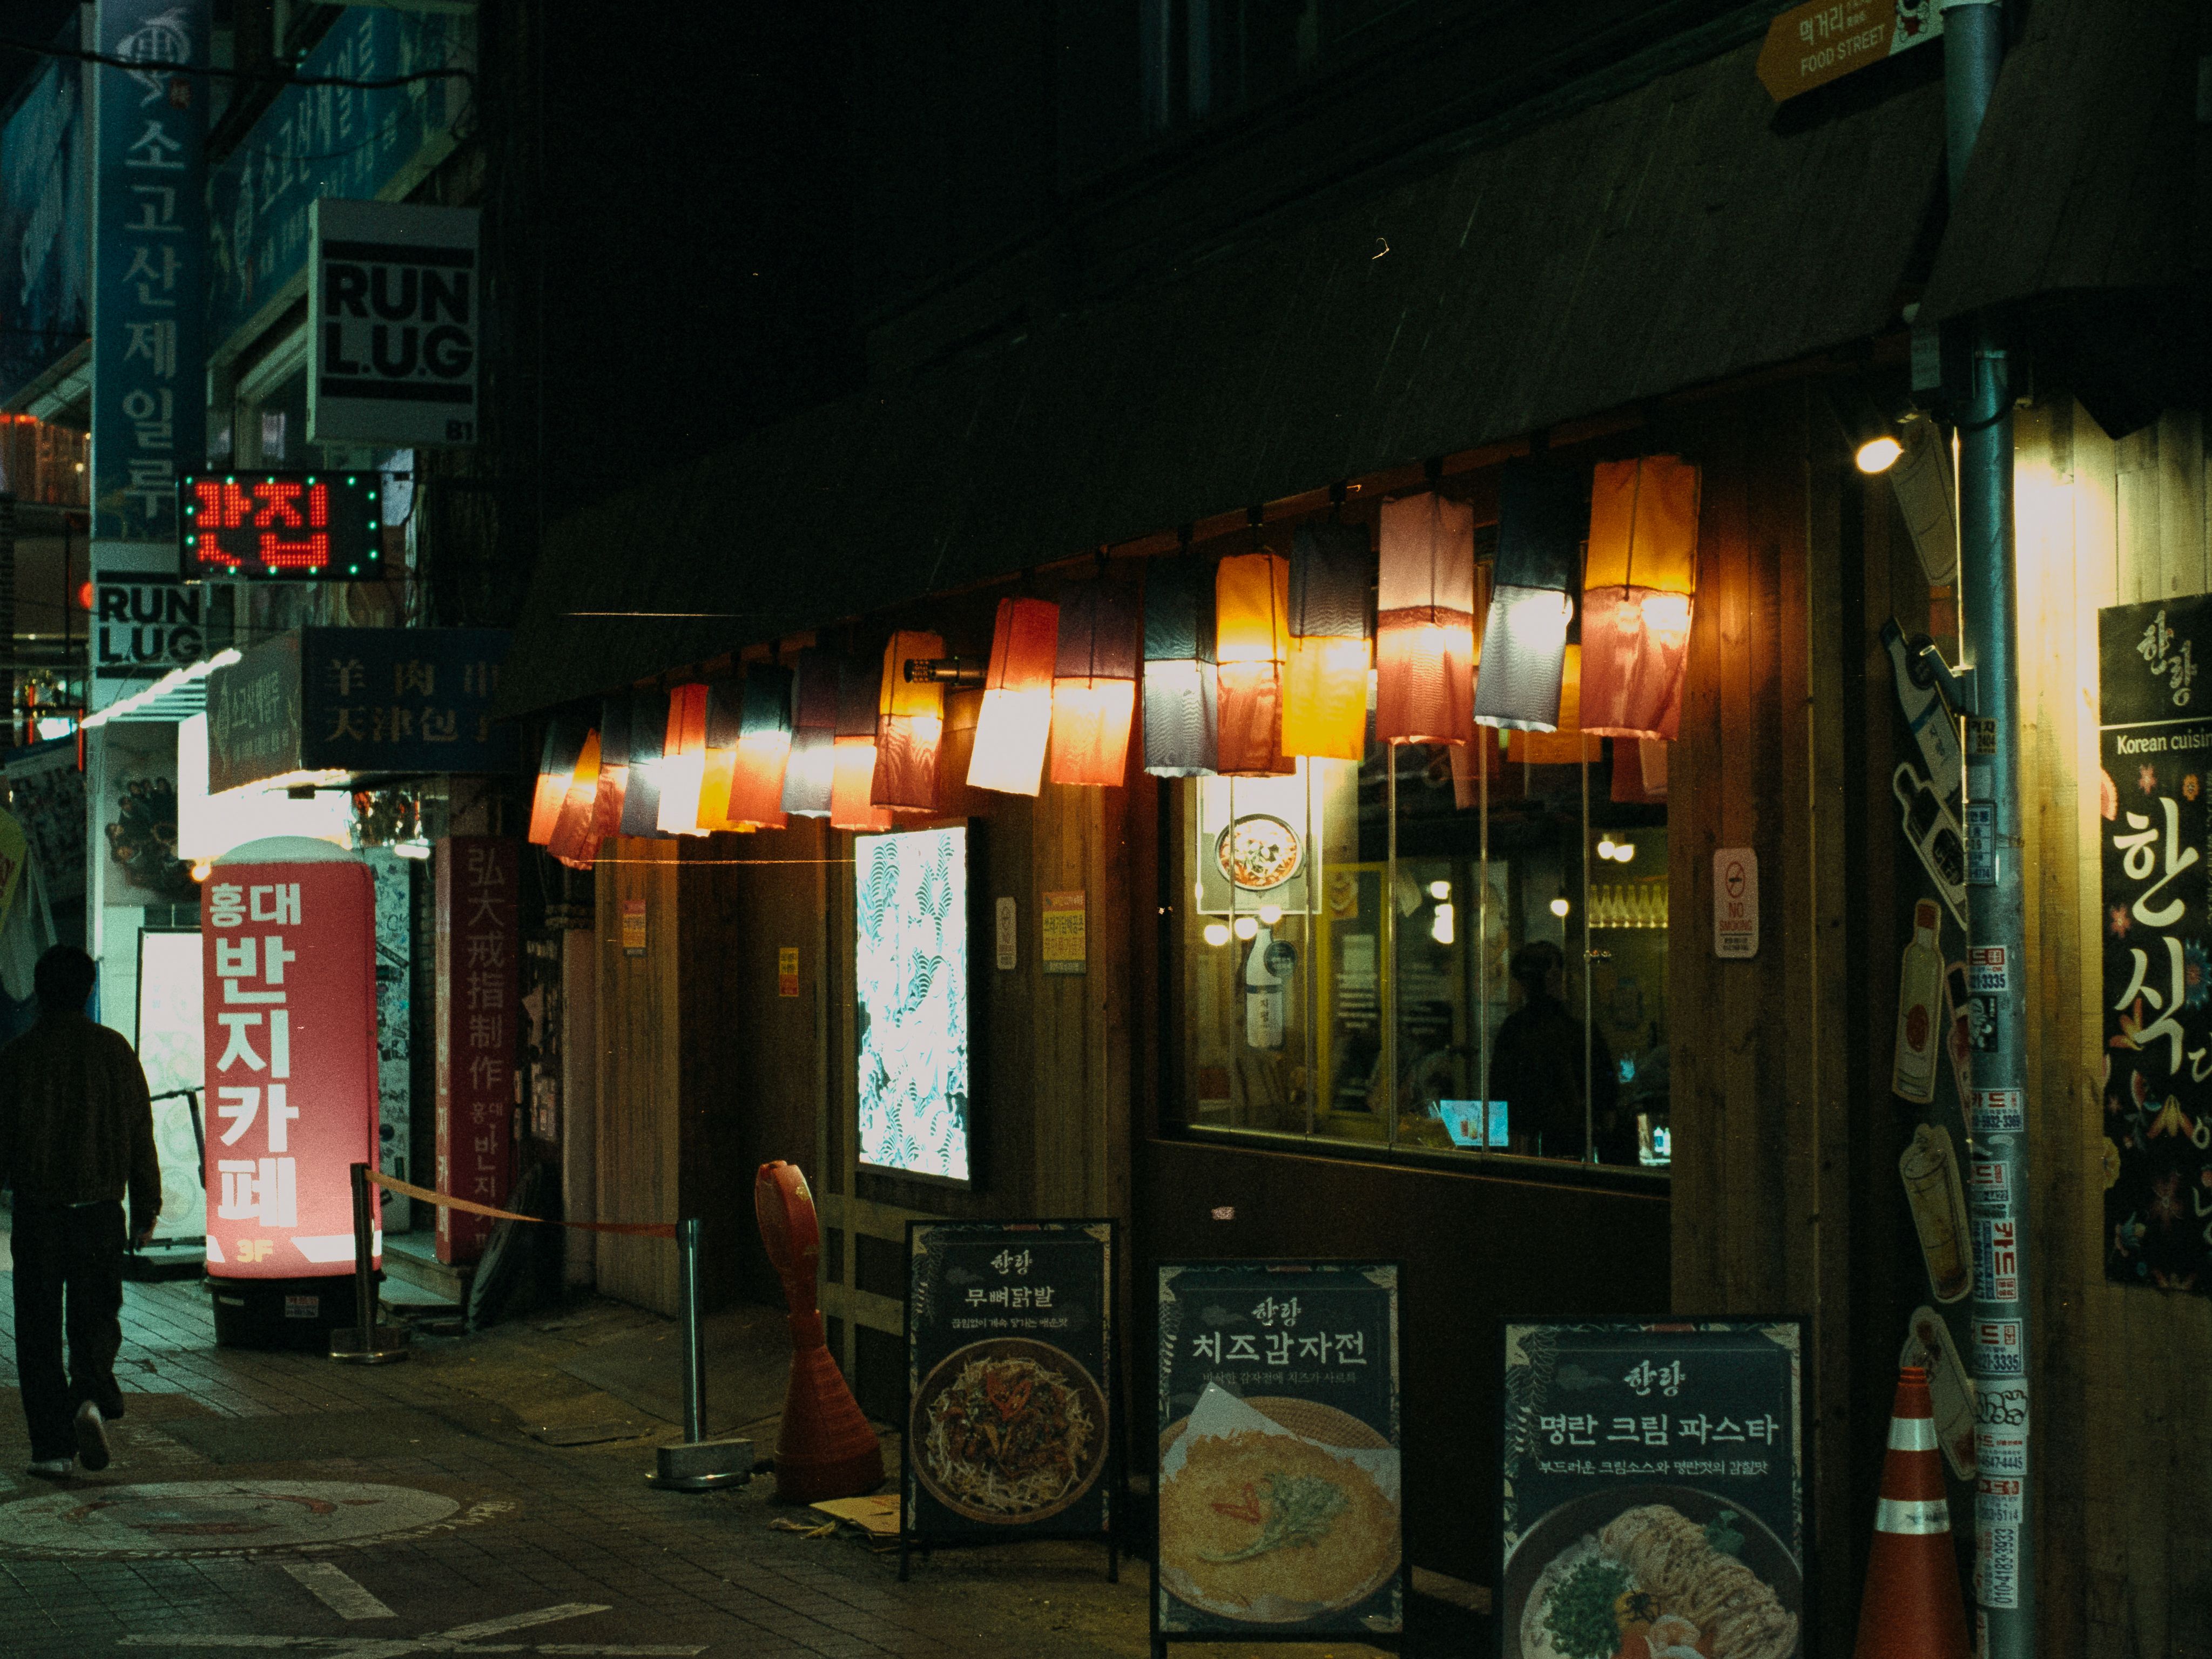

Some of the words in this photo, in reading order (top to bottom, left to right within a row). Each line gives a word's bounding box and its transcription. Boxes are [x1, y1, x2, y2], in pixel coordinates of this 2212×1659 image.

[1800, 47, 1835, 77] FOOD
[1837, 23, 1886, 61] STREET
[325, 264, 469, 323] RUN
[122, 120, 186, 518] 소고산제일루
[325, 322, 474, 378] L.U.G
[98, 586, 200, 625] RUN
[2117, 733, 2168, 756] Korean
[209, 882, 301, 928] 홍대
[1728, 901, 1744, 918] NO
[1719, 920, 1752, 931] SMOKING
[2112, 796, 2200, 1076] 한식
[466, 847, 507, 1091] 弘大戒指制作
[216, 935, 300, 1228] 반지카페
[471, 1101, 503, 1125] 홍대
[236, 1239, 274, 1263] 3F
[1993, 1222, 2015, 1276] 카드
[964, 1285, 1055, 1309] 무뼈닭발
[1192, 1331, 1368, 1365] 치즈감자전
[1239, 1371, 1284, 1385] 감자전에
[1287, 1371, 1321, 1385] 치즈가
[1539, 1413, 1600, 1446] 명란
[1606, 1413, 1669, 1446] 크림
[1677, 1413, 1781, 1446] 파스타
[1539, 1460, 1596, 1475] 부드러운
[1599, 1460, 1671, 1475] 크림소스와
[1673, 1460, 1725, 1475] 명란젓의
